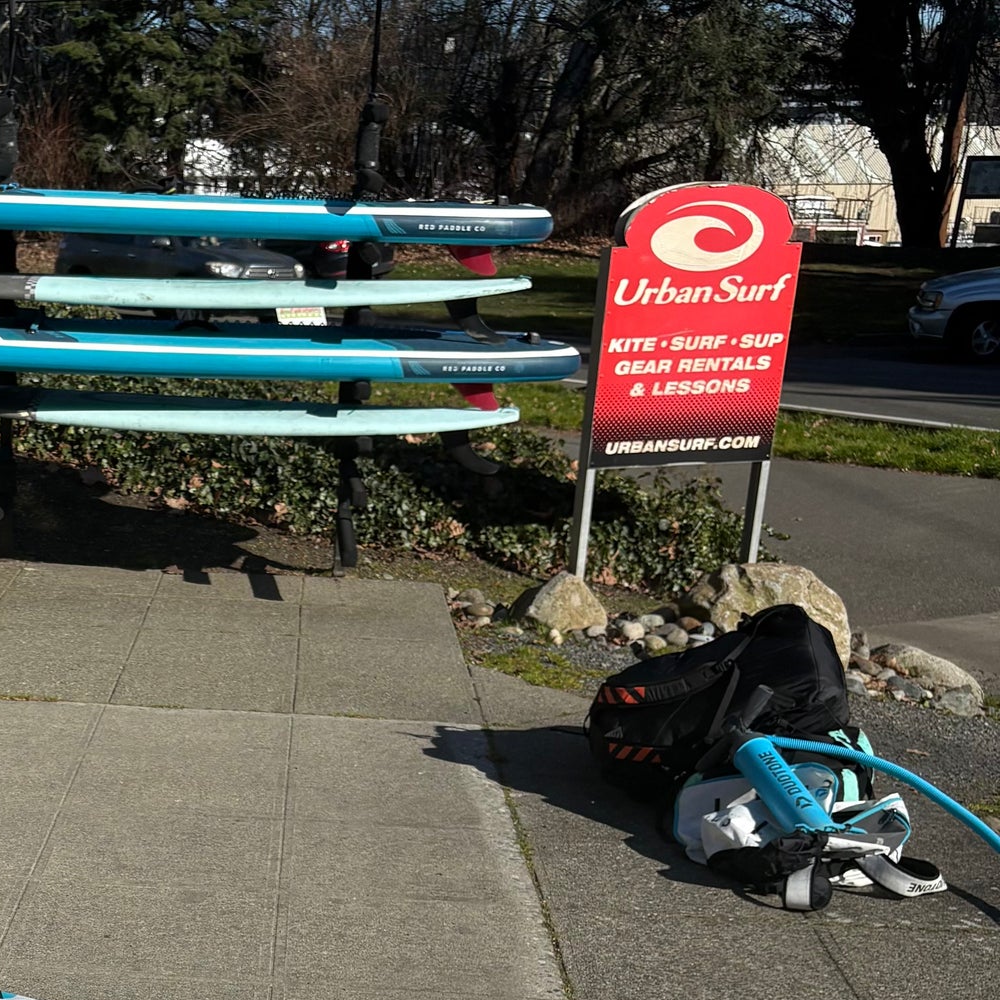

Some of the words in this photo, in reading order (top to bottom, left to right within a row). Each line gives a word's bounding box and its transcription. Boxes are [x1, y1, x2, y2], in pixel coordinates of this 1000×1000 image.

[418, 224, 435, 232] RED
[438, 224, 472, 232] PADDLE
[608, 338, 657, 353] KITE
[669, 335, 728, 351] SURF
[739, 333, 784, 349] SUP
[614, 359, 672, 375] GEAR
[677, 355, 772, 373] RENTALS
[629, 382, 645, 397] &
[652, 378, 751, 396] LESSONS
[605, 435, 761, 455] URBANSURF.COM
[758, 750, 802, 796] DUOTONE
